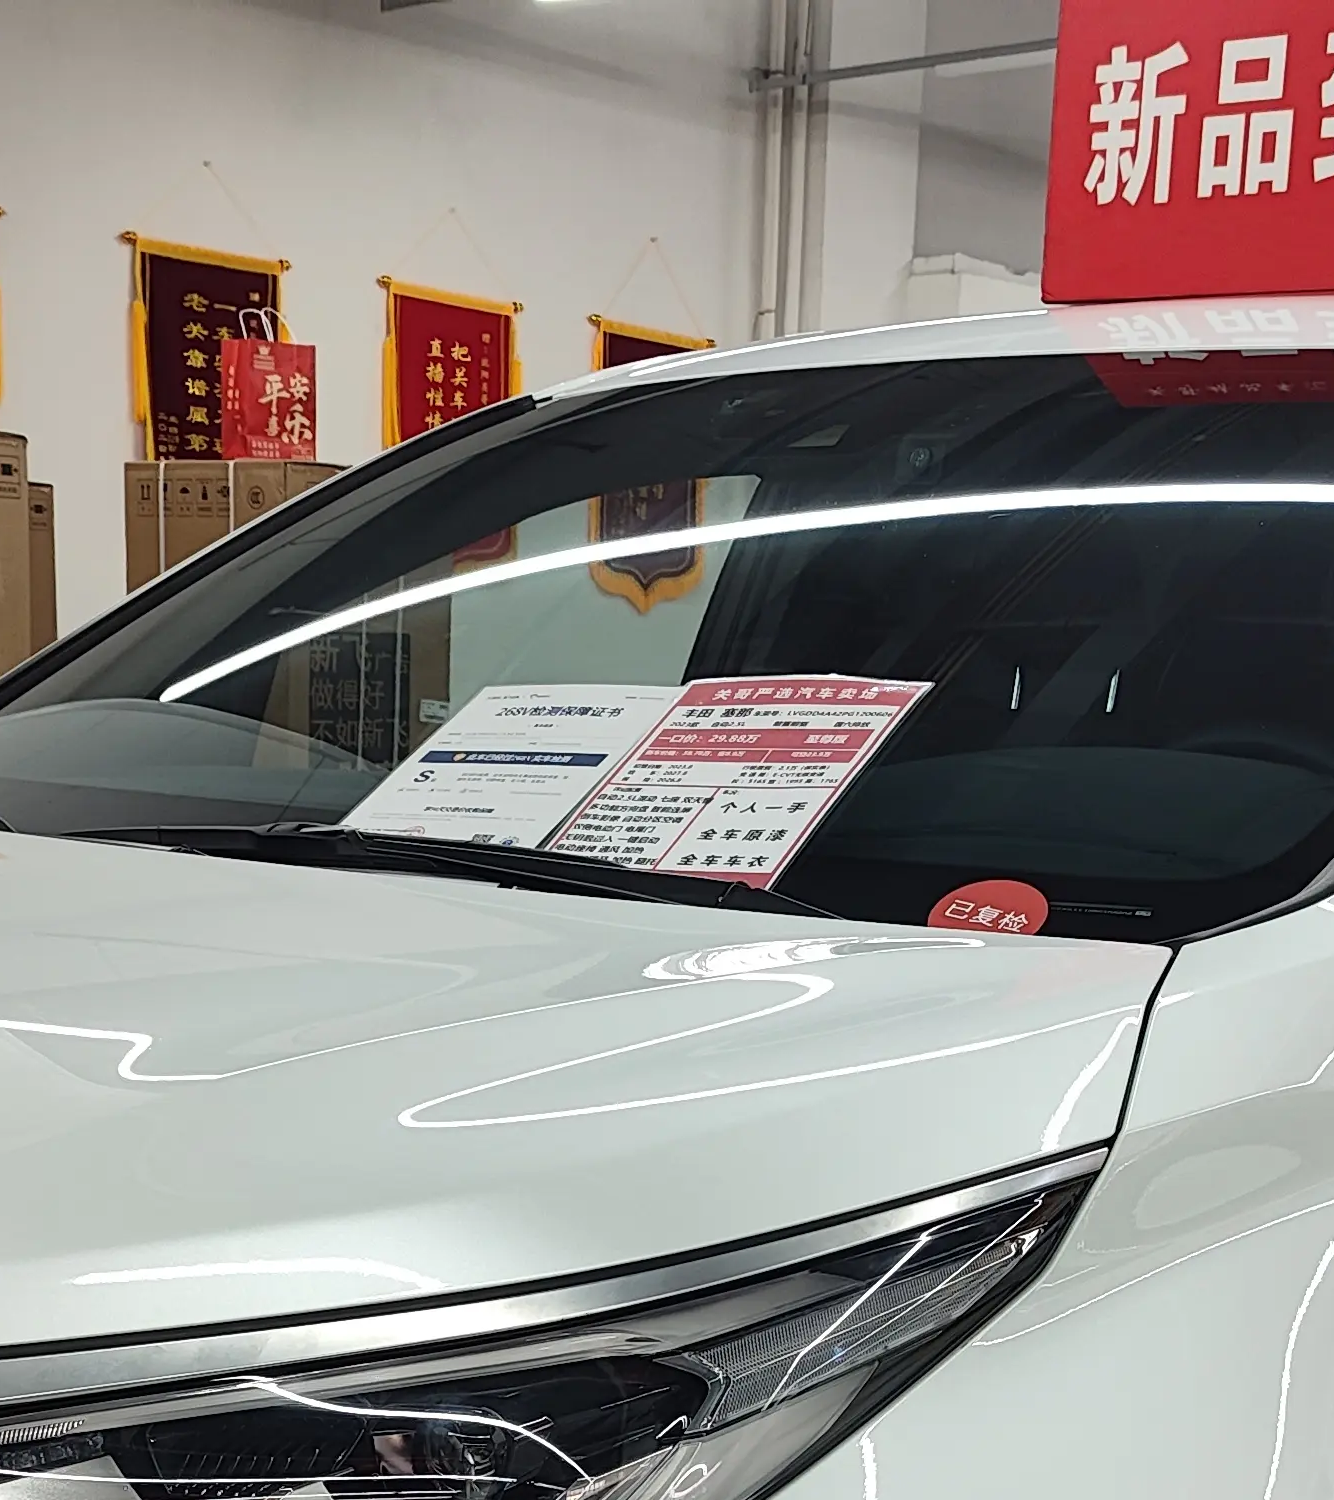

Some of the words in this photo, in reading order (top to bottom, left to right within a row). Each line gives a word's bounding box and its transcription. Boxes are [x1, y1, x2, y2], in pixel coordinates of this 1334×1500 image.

[449, 341, 472, 416] 把关车
[258, 372, 311, 415] 平安
[712, 687, 879, 701] 关哥严选汽车卖场
[682, 708, 715, 718] 丰田
[720, 707, 754, 718] 塞那
[720, 801, 808, 814] 个人一手
[696, 828, 789, 842] 全车原漆
[676, 853, 770, 868] 全车车衣
[944, 899, 1029, 932] 已复检
